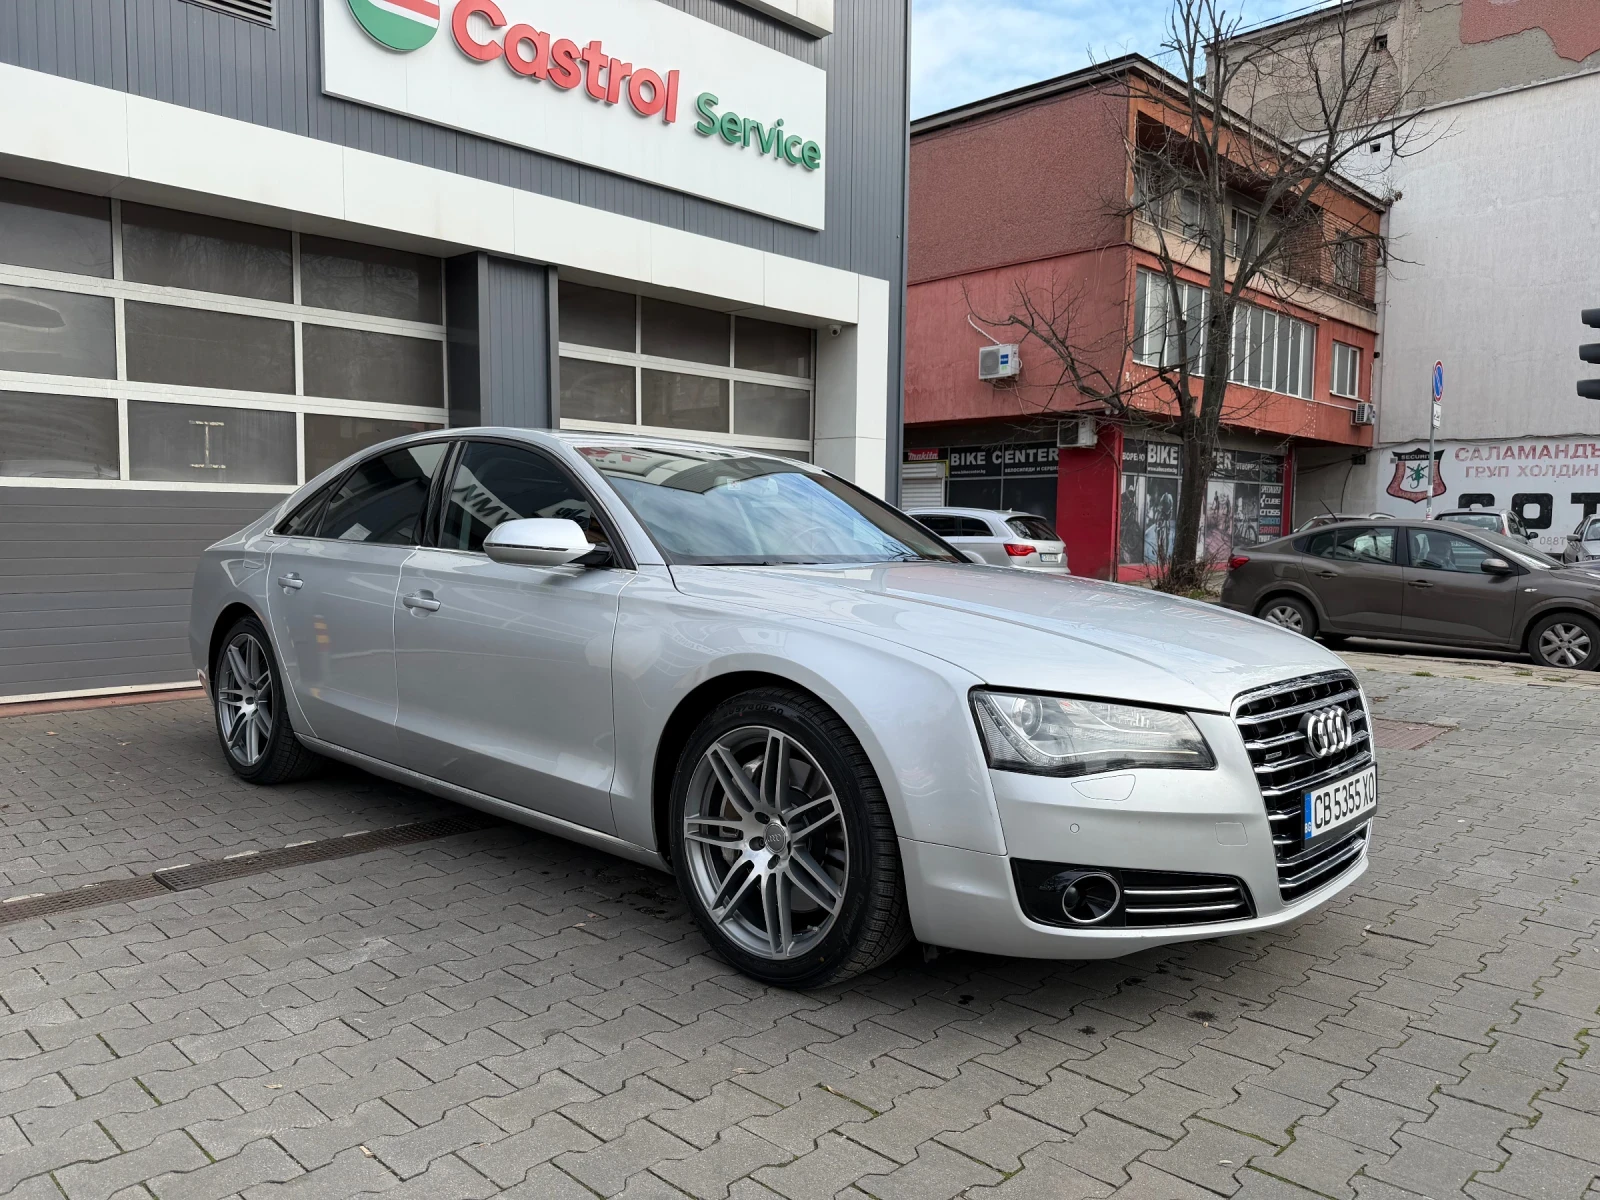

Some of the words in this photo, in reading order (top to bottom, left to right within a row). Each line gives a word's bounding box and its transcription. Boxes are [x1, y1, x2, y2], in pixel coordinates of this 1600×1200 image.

[451, 0, 680, 124] Castrol
[695, 92, 822, 171] Service
[950, 452, 986, 466] BIKE
[992, 447, 1059, 465] CENTER
[1147, 444, 1178, 465] BIKE
[1465, 465, 1510, 478] ГРУП
[1516, 463, 1599, 479] ХОЛДИН
[1333, 777, 1361, 821] 5355
